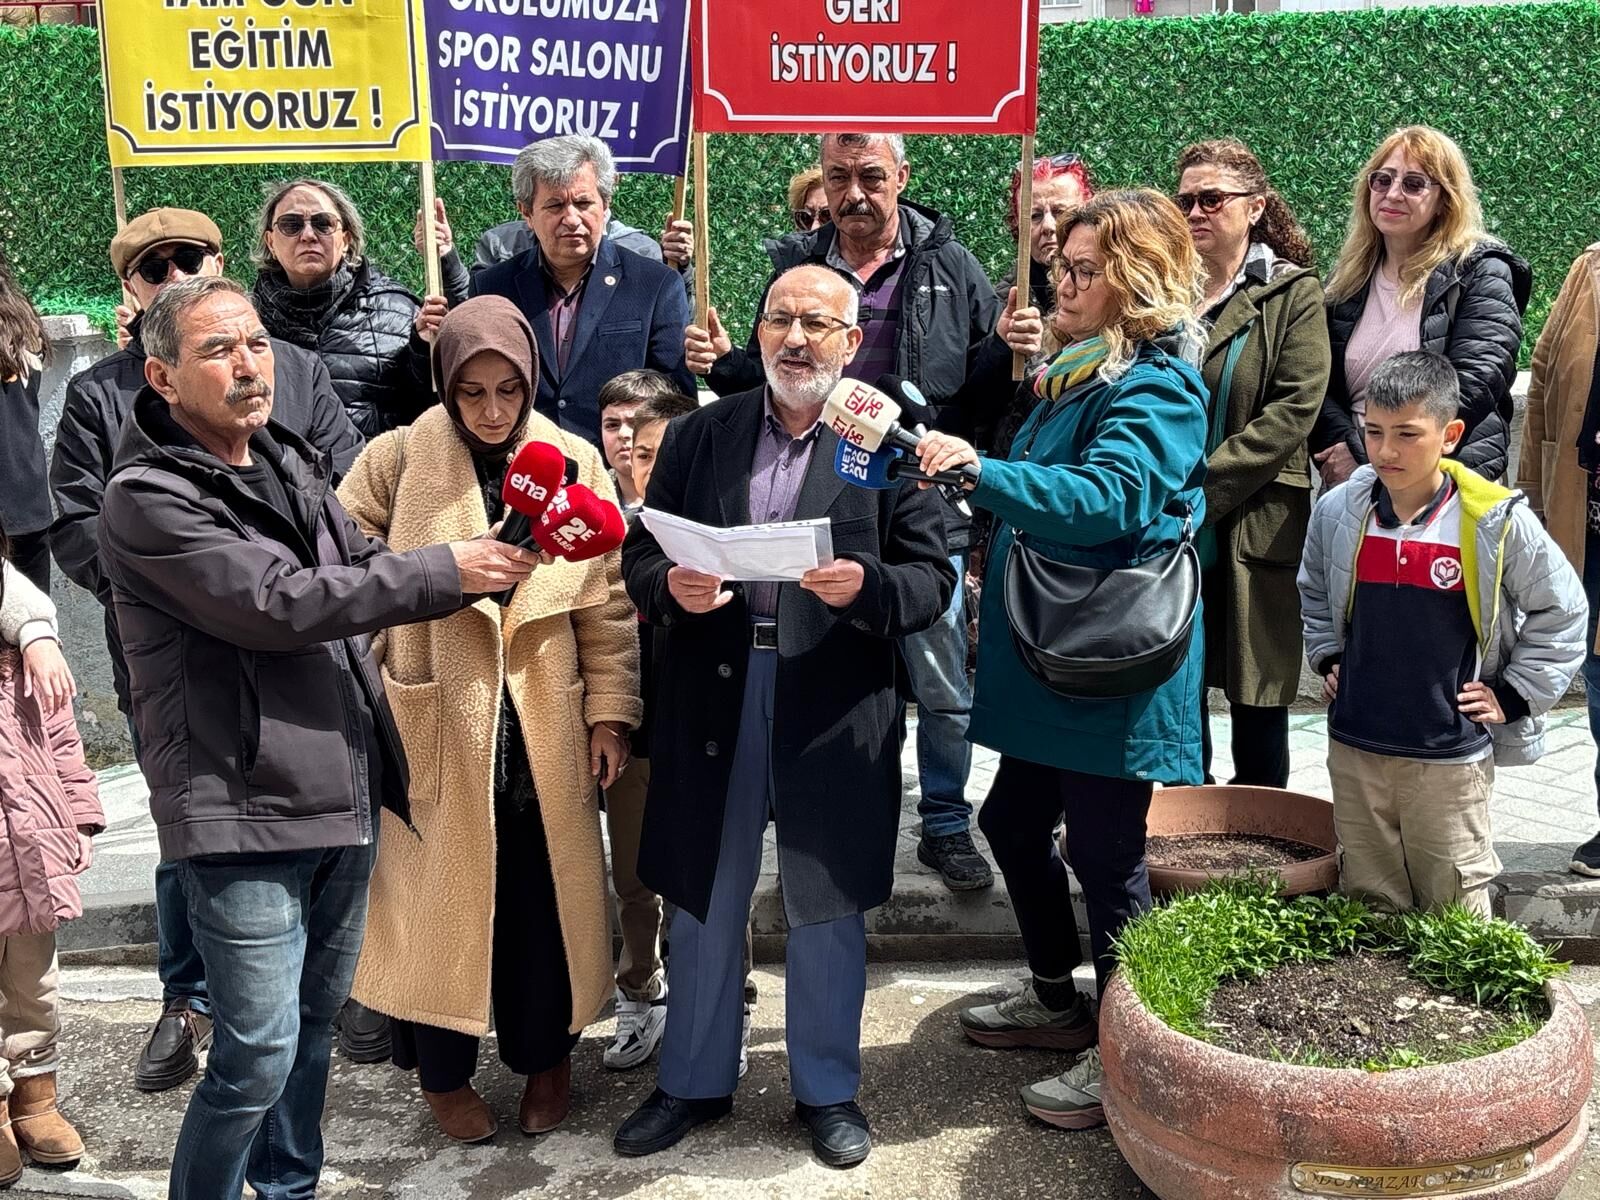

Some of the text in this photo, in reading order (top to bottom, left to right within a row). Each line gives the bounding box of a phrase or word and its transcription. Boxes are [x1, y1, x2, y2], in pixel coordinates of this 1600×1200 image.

[190, 18, 332, 69] EĞİTİM
[438, 30, 663, 83] SPOR SALONU
[770, 32, 958, 83] İSTİYORUZ !
[145, 81, 384, 131] İSTİYORUZ !
[453, 78, 639, 139] İSTİYORUZ !
[844, 385, 868, 411] GZT
[864, 398, 884, 419] 26
[841, 445, 853, 474] NET
[854, 450, 870, 481] 26
[549, 531, 575, 552] HABER
